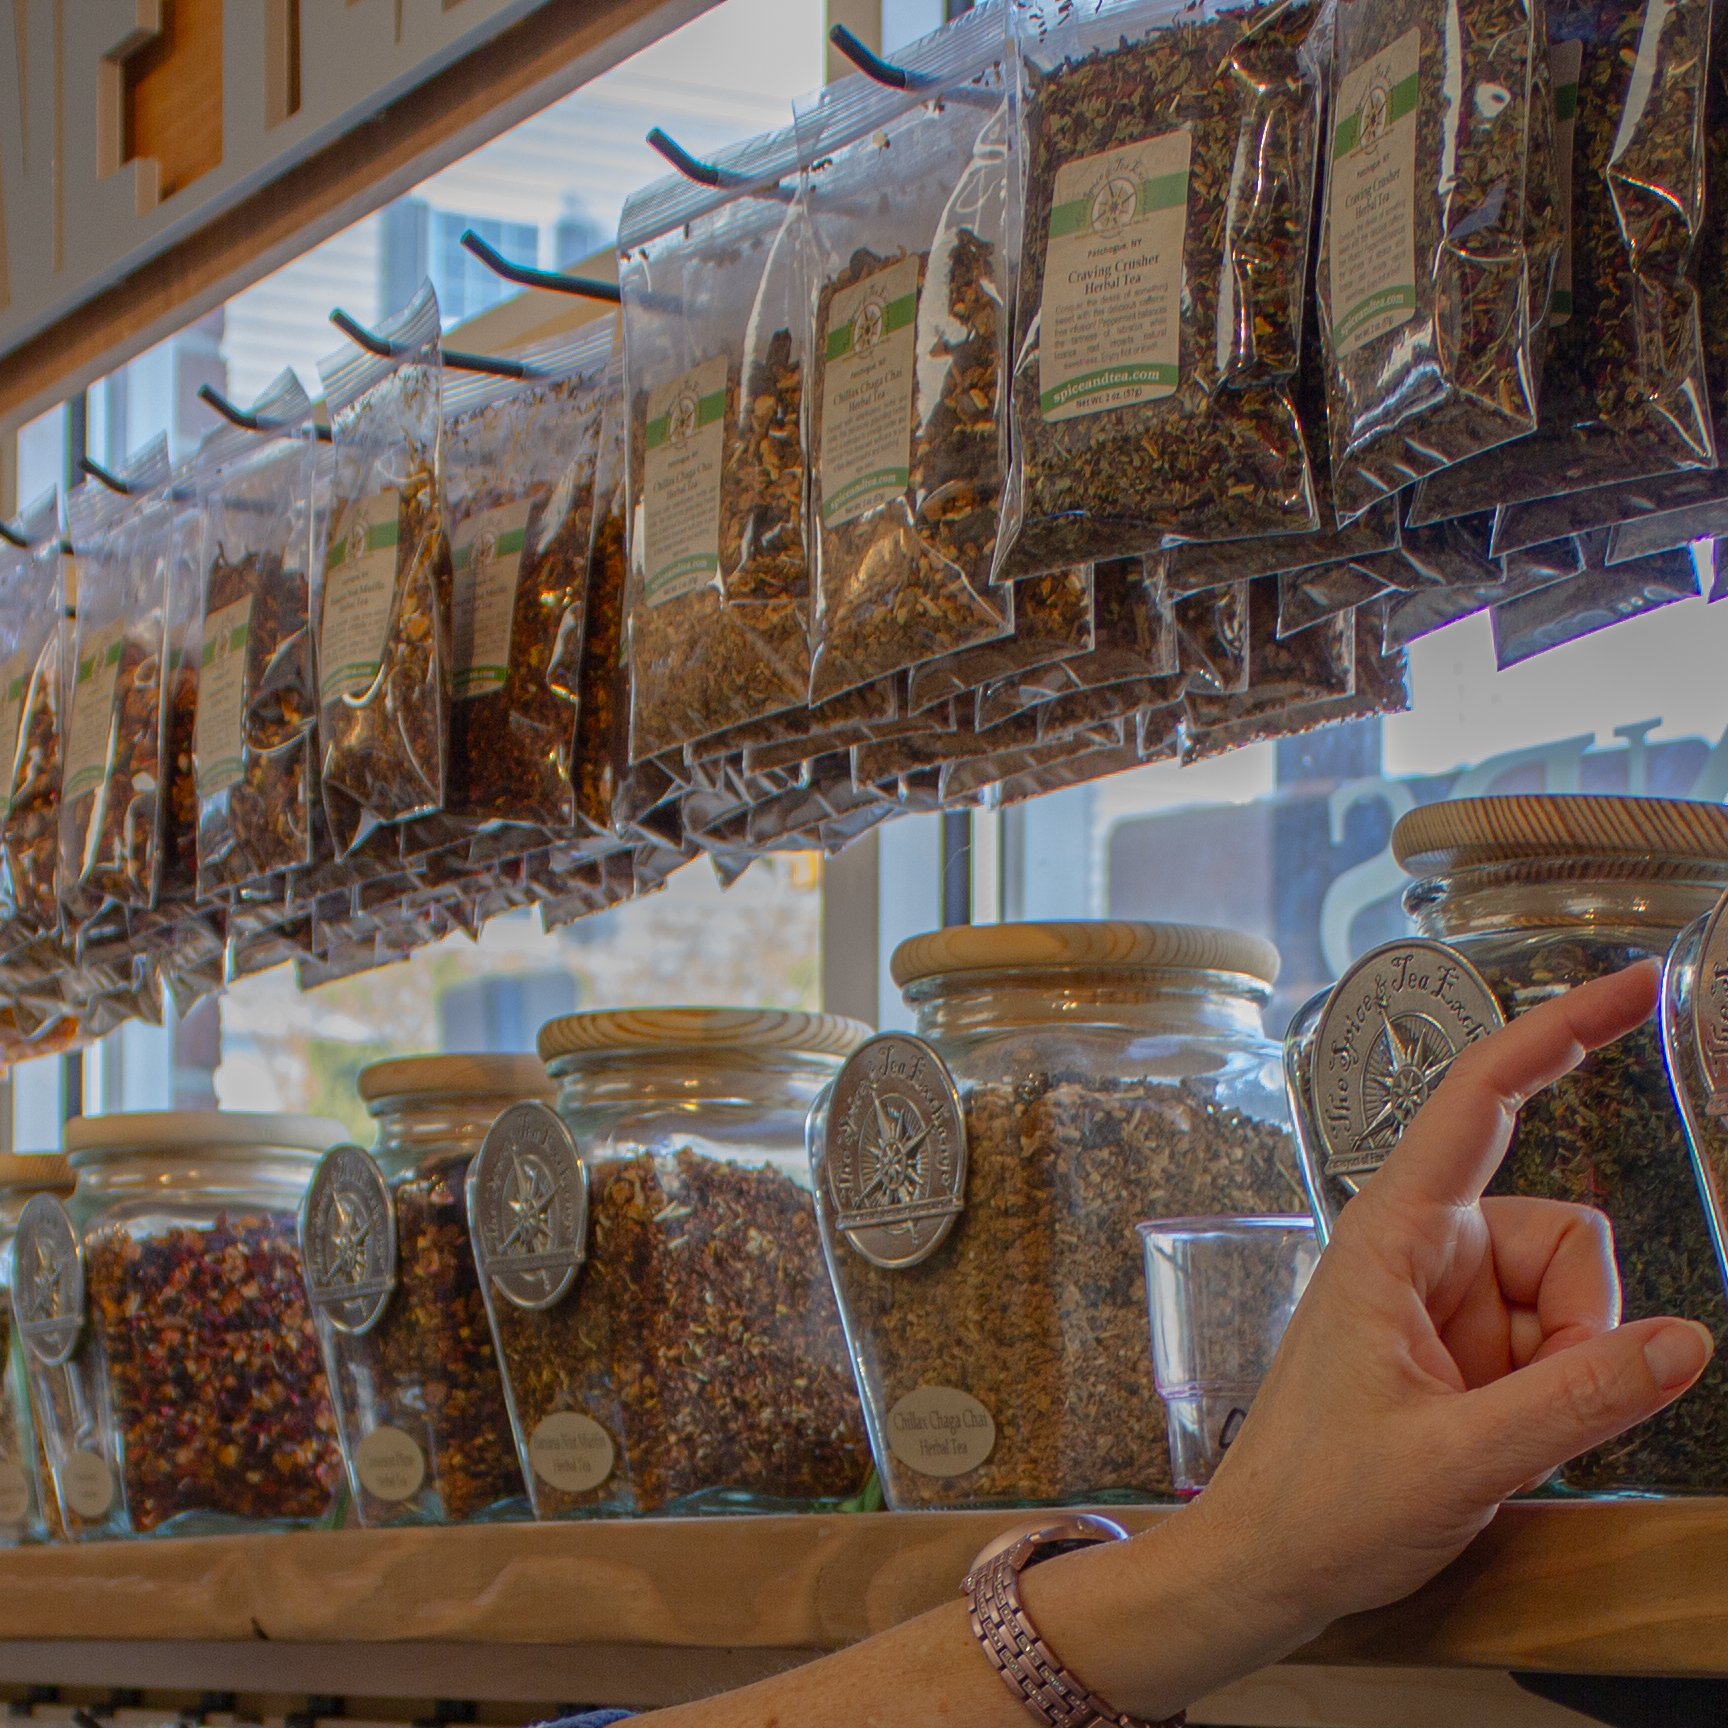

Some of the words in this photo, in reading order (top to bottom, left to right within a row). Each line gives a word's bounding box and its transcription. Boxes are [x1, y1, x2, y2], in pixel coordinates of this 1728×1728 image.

[1345, 183, 1371, 209] Craving
[1373, 168, 1401, 191] Crusher
[1355, 200, 1376, 219] Herbal
[1378, 191, 1390, 206] Tea
[1068, 265, 1112, 284] Craving
[1115, 253, 1160, 273] Crusher
[1085, 277, 1120, 295] Herbal
[1123, 274, 1141, 286] Tea
[848, 395, 873, 413] Herbal
[874, 389, 886, 403] Tea
[1053, 370, 1160, 403] spiceandtea.com
[1076, 399, 1089, 408] Net
[1391, 954, 1430, 993] Tea
[1431, 965, 1492, 1040] Exch
[1329, 993, 1372, 1072] Spice
[878, 1045, 906, 1077] Tea
[1326, 1078, 1351, 1139] The
[893, 1411, 928, 1430] Chillax
[929, 1410, 961, 1436] Chaga
[962, 1408, 988, 1428] Chai
[920, 1439, 949, 1456] Herbal
[951, 1439, 968, 1455] Tea
